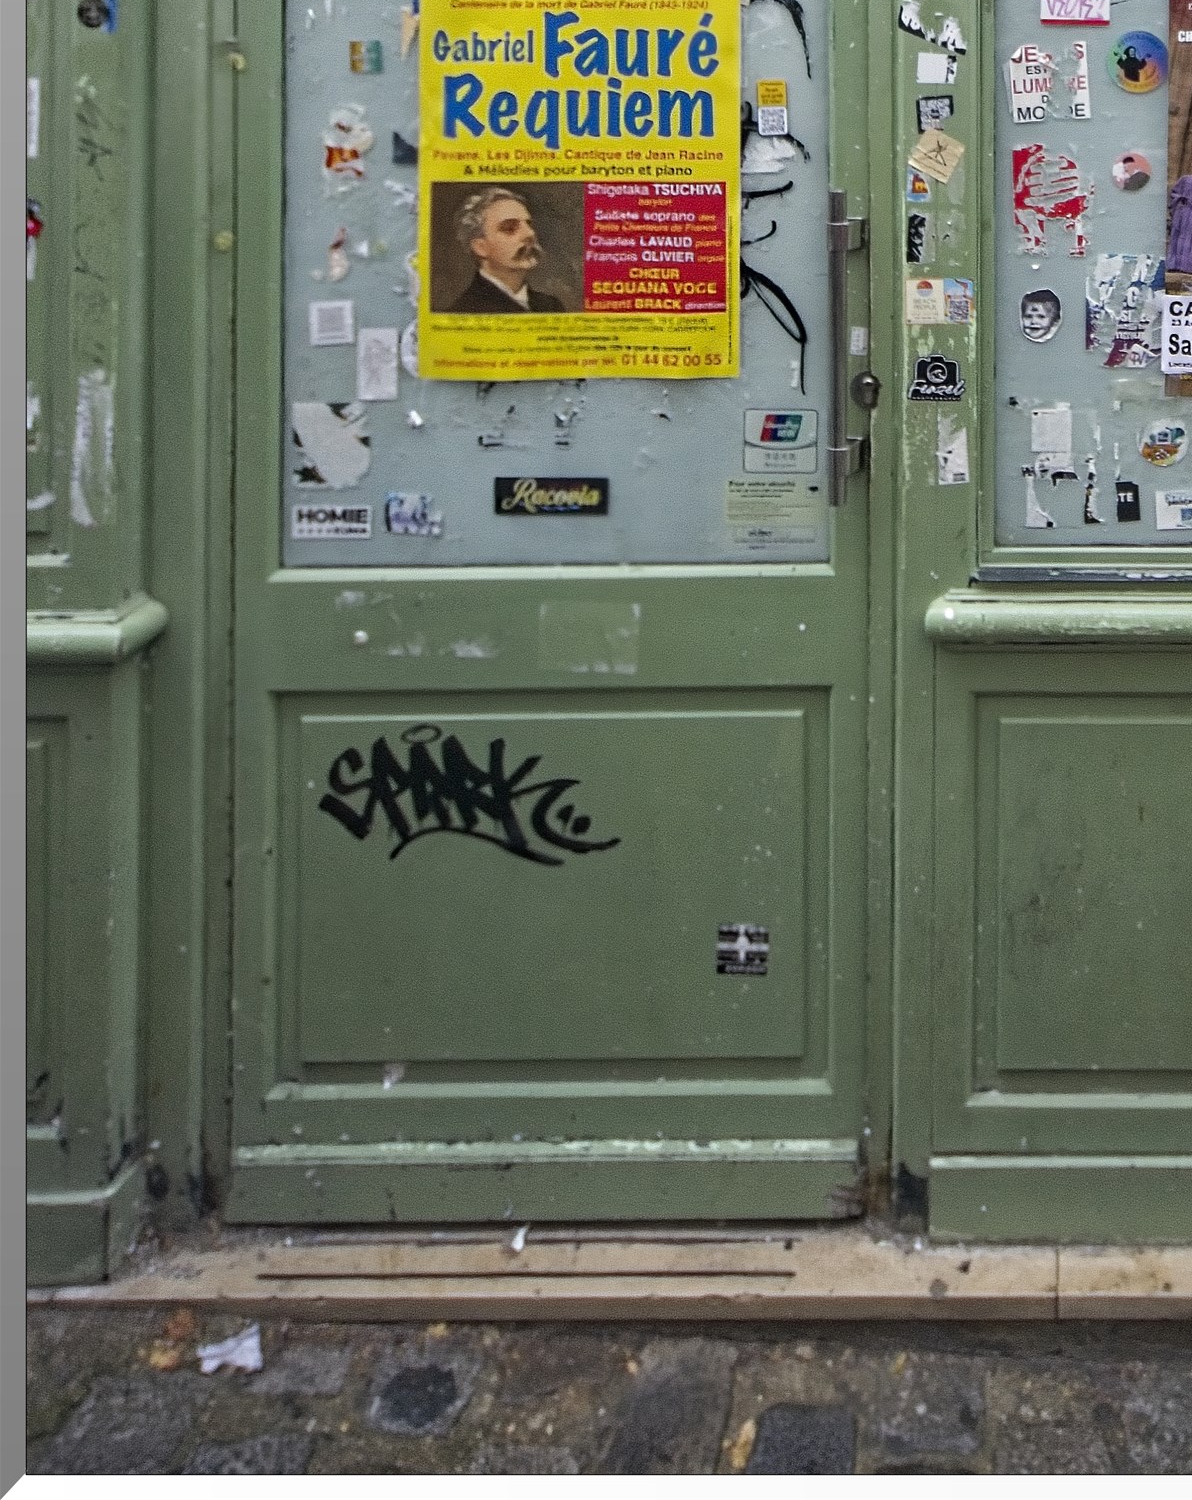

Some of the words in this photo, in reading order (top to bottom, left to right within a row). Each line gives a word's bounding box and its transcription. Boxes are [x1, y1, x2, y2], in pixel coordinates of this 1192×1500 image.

[433, 30, 534, 63] Gabriel
[544, 11, 720, 78] Fauré
[443, 73, 714, 150] Requiem
[564, 149, 622, 161] Cantique
[626, 150, 642, 160] de
[646, 150, 674, 160] Jean
[679, 149, 724, 160] Racine
[581, 165, 635, 177] baryton
[638, 166, 652, 176] et
[656, 165, 693, 177] piano
[653, 184, 722, 195] TSUCHIYA
[643, 212, 695, 223] soprano
[640, 237, 692, 248] LAVAUD
[641, 251, 694, 263] OLIVIER
[674, 283, 717, 295] VOCE
[635, 299, 682, 310] BRACK
[621, 354, 637, 366] 01
[642, 354, 659, 366] 44
[683, 354, 701, 366] 00
[704, 353, 722, 366] 55
[297, 508, 368, 524] HOMIE
